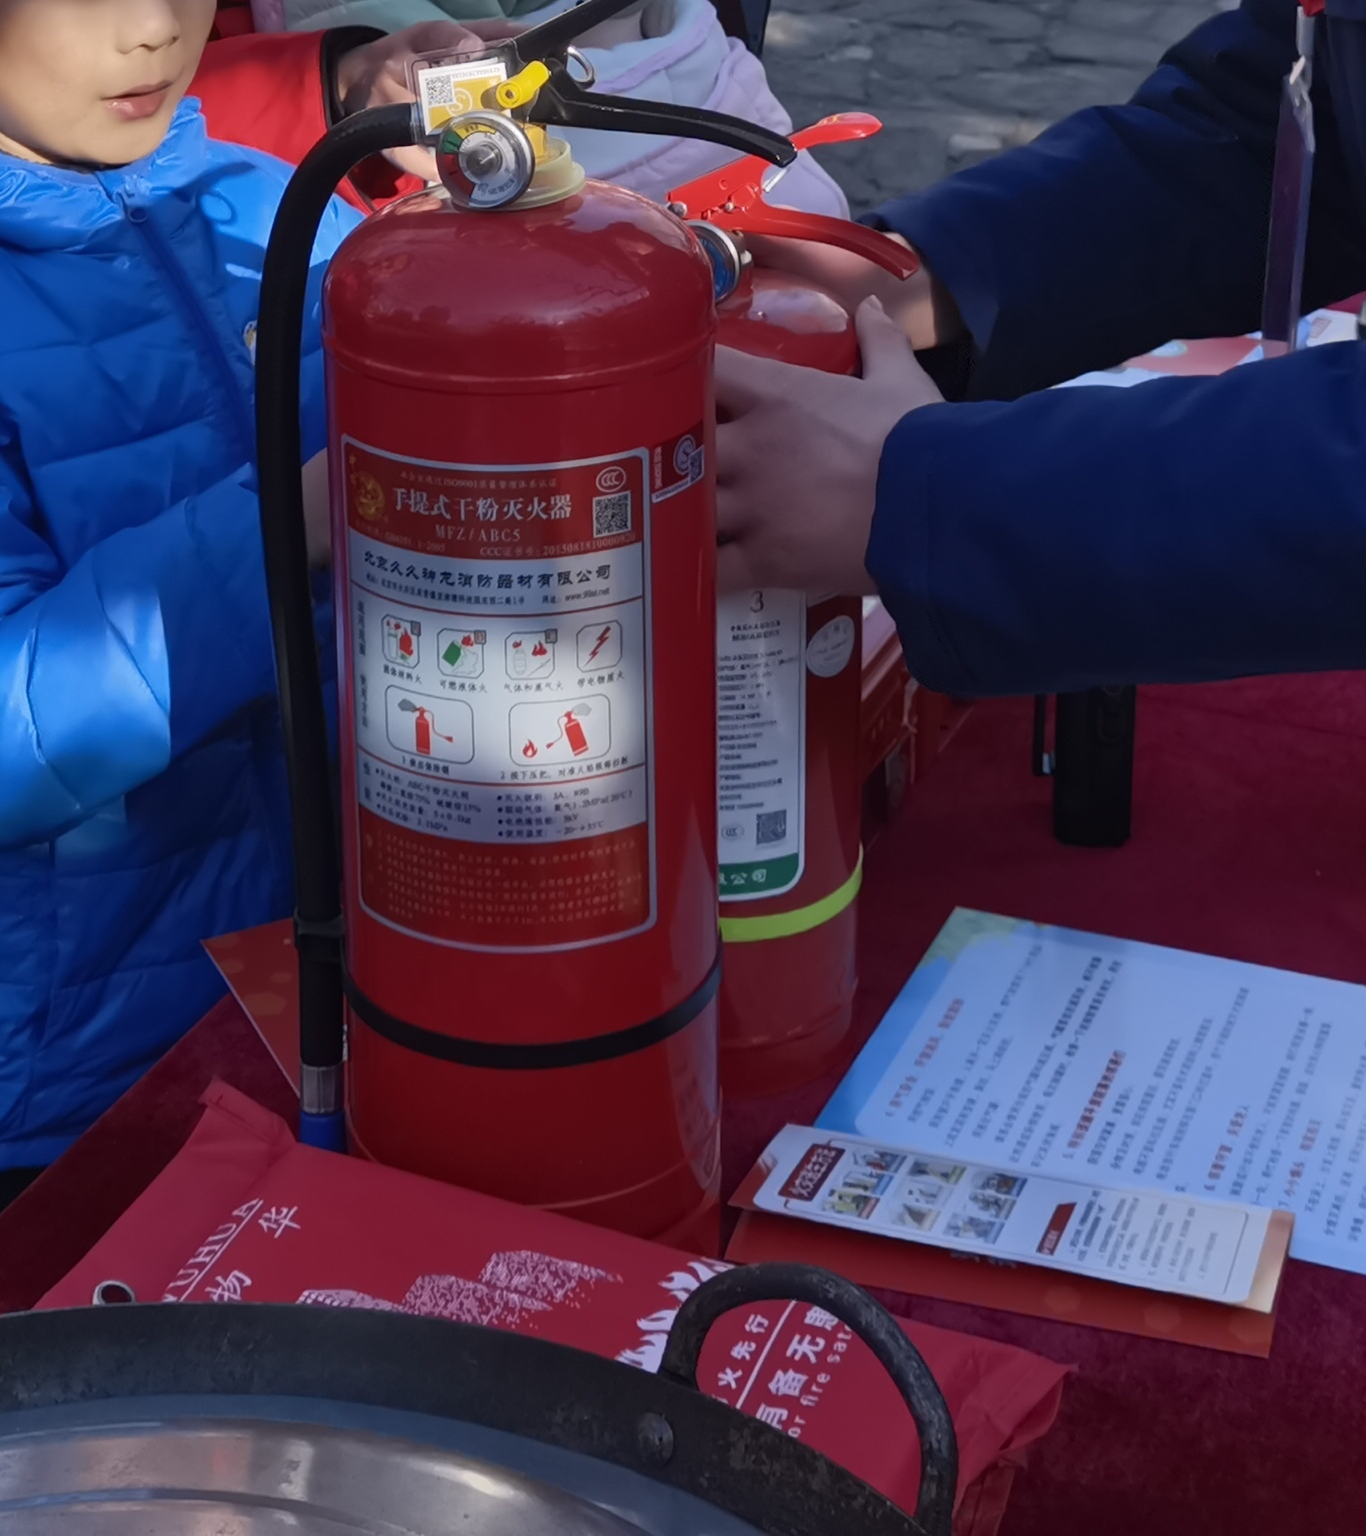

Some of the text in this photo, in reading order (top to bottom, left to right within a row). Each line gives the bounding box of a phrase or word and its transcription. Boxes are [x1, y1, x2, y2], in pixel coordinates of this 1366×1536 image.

[392, 487, 573, 522] 手提式干粉灭火器
[434, 524, 521, 543] MFZ/ABC5
[363, 548, 612, 590] 北京久久神龙消防器材有限公司
